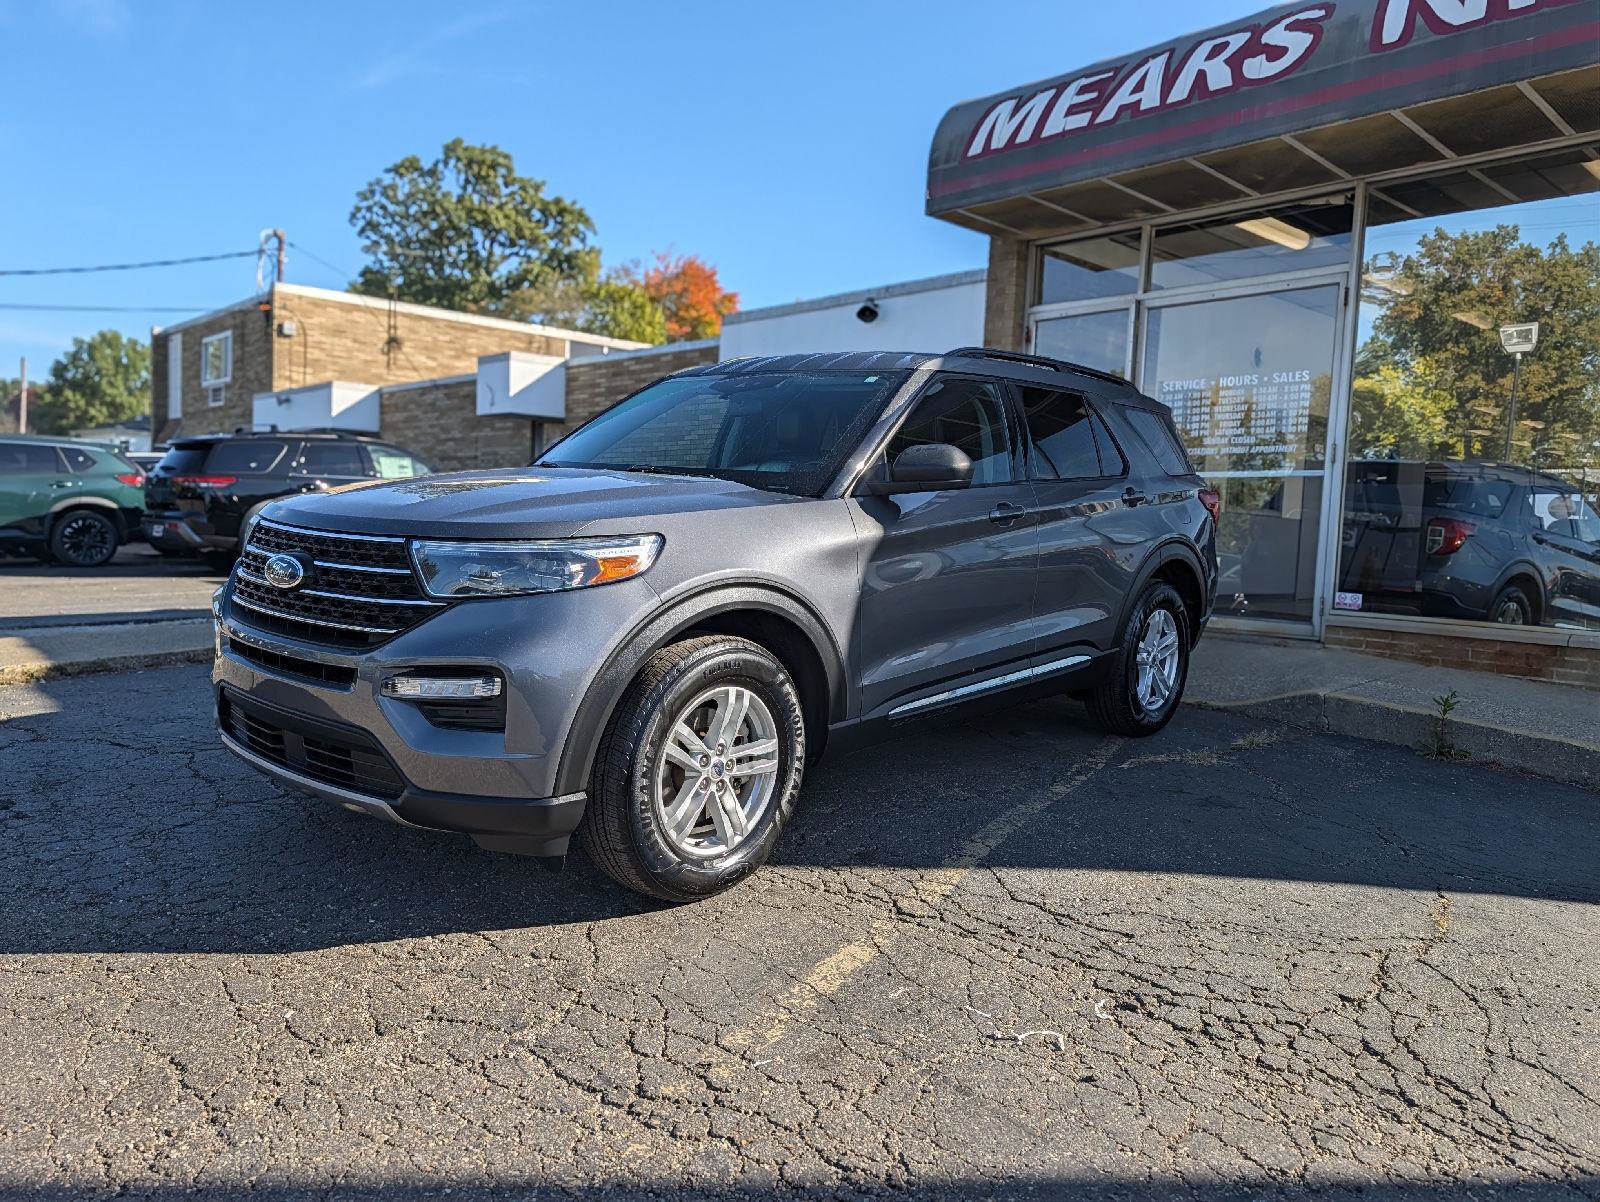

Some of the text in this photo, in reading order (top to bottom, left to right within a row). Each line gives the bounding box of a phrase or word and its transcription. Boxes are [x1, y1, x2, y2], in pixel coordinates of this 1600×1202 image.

[964, 6, 1332, 159] MEARS
[1162, 370, 1310, 392] SERVICE HOURS SALES
